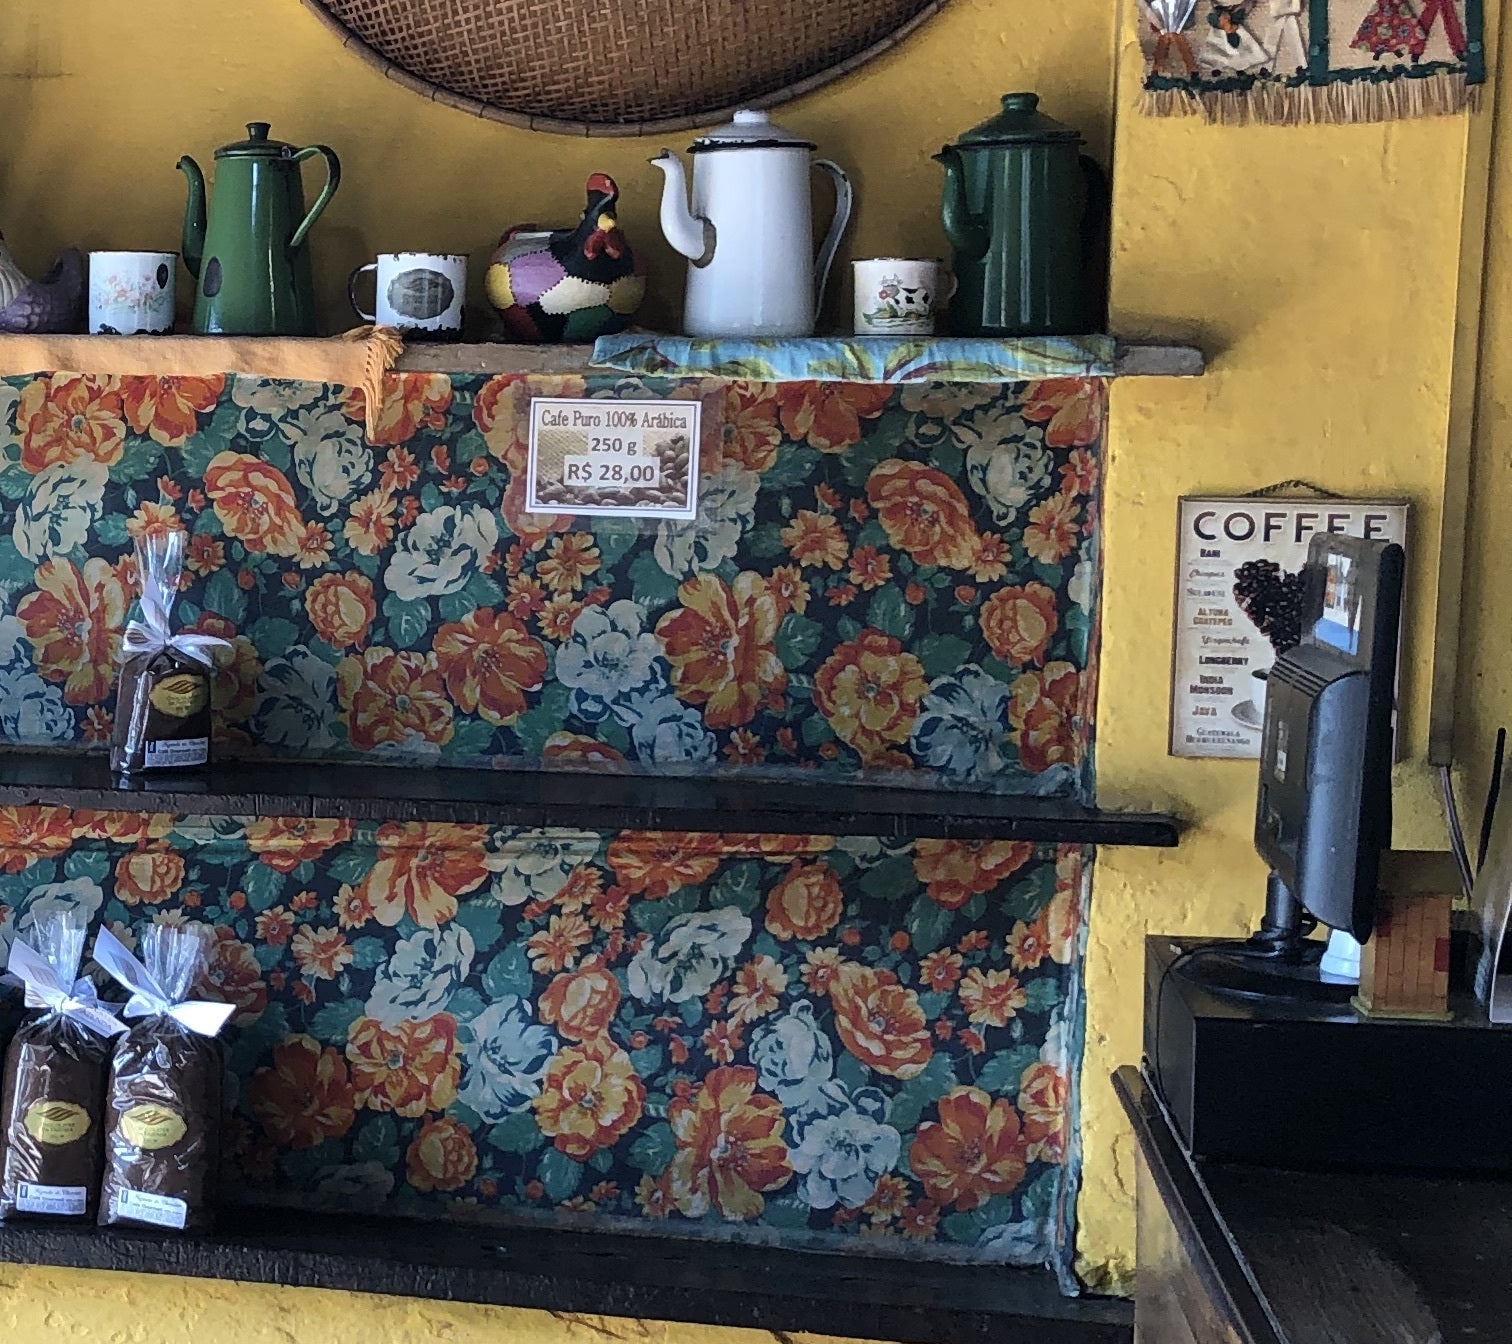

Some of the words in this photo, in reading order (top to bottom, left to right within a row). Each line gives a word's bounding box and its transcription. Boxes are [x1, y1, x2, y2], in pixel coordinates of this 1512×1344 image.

[541, 409, 569, 427] Cafe
[573, 410, 601, 428] Puro
[605, 411, 637, 428] 100%
[641, 412, 687, 429] Arábica
[591, 437, 622, 452] 250
[627, 441, 637, 456] g
[567, 461, 592, 483] R$
[598, 464, 655, 485] 28,00
[1193, 510, 1390, 543] COFFEE
